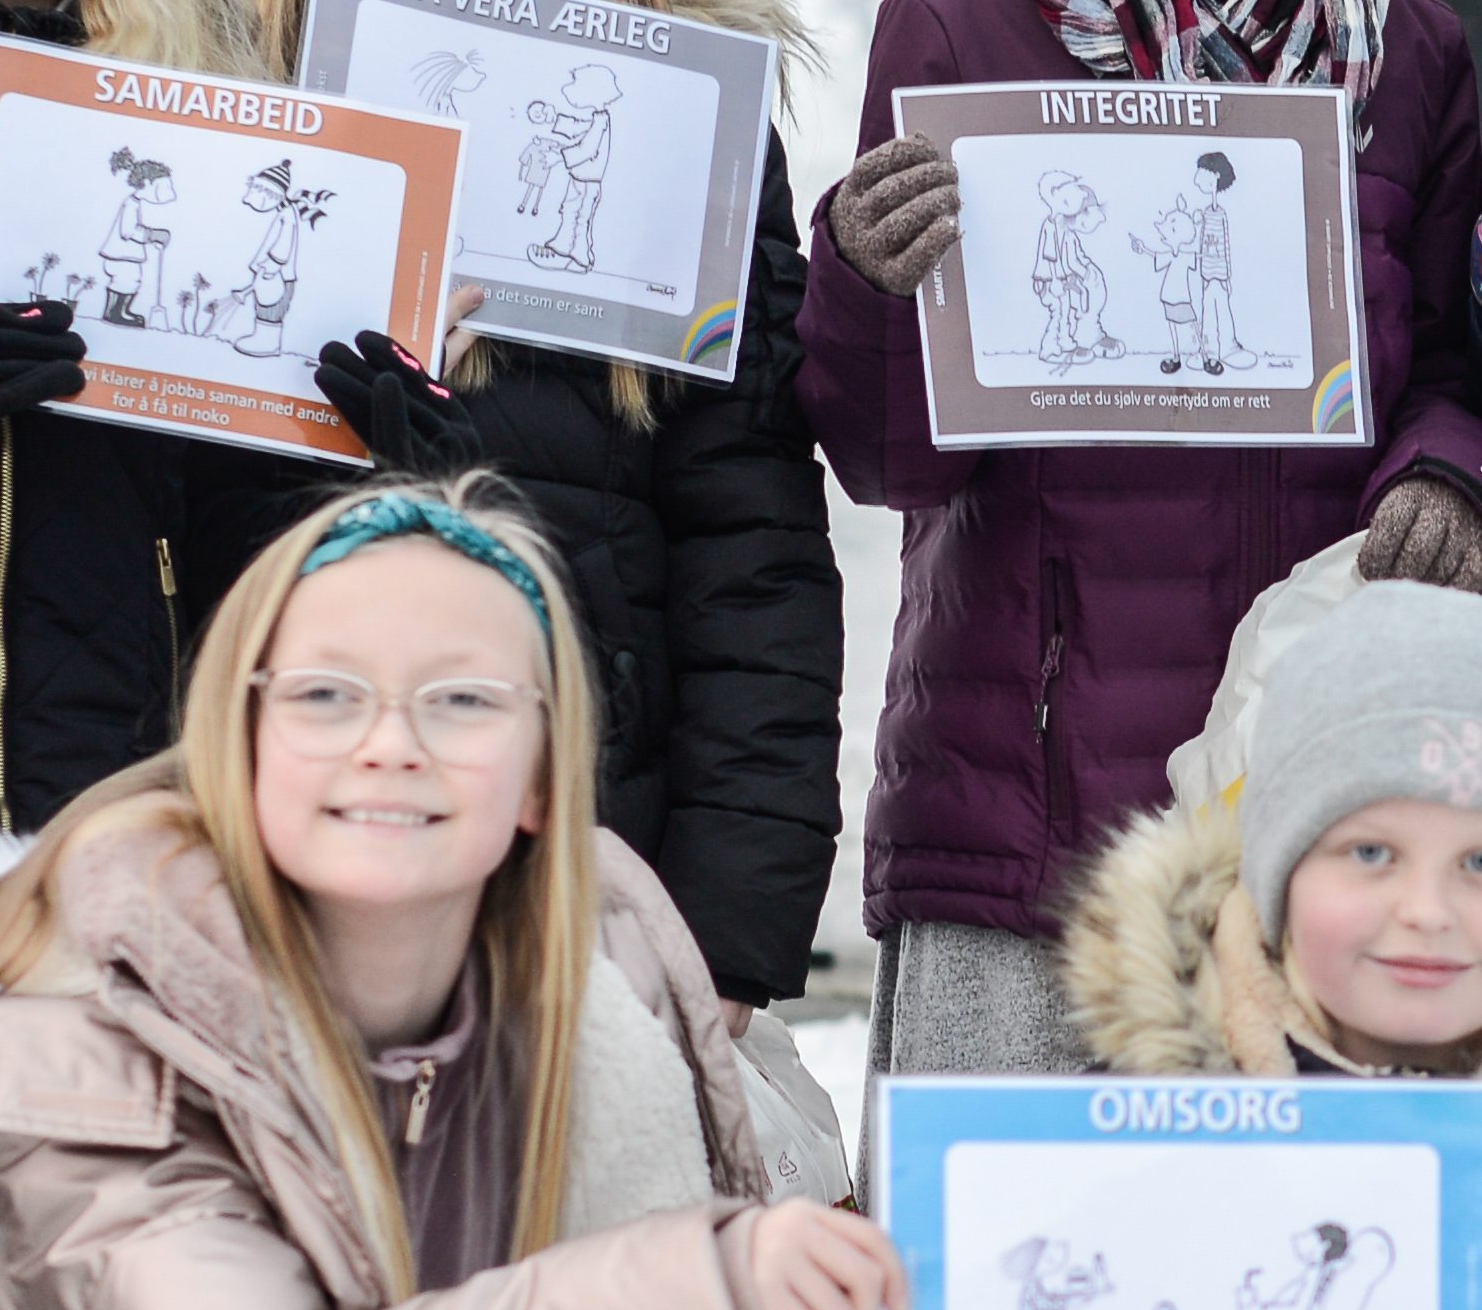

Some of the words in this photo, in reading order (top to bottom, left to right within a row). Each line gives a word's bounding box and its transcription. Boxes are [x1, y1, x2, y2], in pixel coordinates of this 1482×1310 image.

[549, 3, 670, 55] ÆRLEG
[94, 69, 324, 135] SAMARBEID
[1039, 91, 1221, 127] INTEGRITET
[496, 288, 520, 303] det
[524, 294, 552, 308] som
[556, 299, 570, 311] er
[574, 302, 603, 319] sant
[84, 368, 96, 381] vi
[101, 369, 144, 389] klarer
[149, 376, 159, 392] å
[162, 379, 204, 399] jobba
[209, 389, 256, 409] saman
[261, 395, 294, 416] med
[297, 403, 339, 426] andre
[113, 392, 134, 409] for
[138, 395, 148, 411] å
[153, 399, 168, 415] få
[172, 403, 187, 418] til
[191, 404, 229, 426] noko
[1030, 391, 1066, 409] Gjera
[1070, 391, 1091, 406] det
[1095, 391, 1111, 406] du
[1115, 391, 1140, 409] sjølv
[1144, 394, 1156, 406] er
[1159, 393, 1208, 411] overtydd
[1212, 395, 1230, 408] om
[1234, 396, 1245, 408] er
[1248, 395, 1270, 409] rett
[1089, 1088, 1302, 1132] OMSORG
